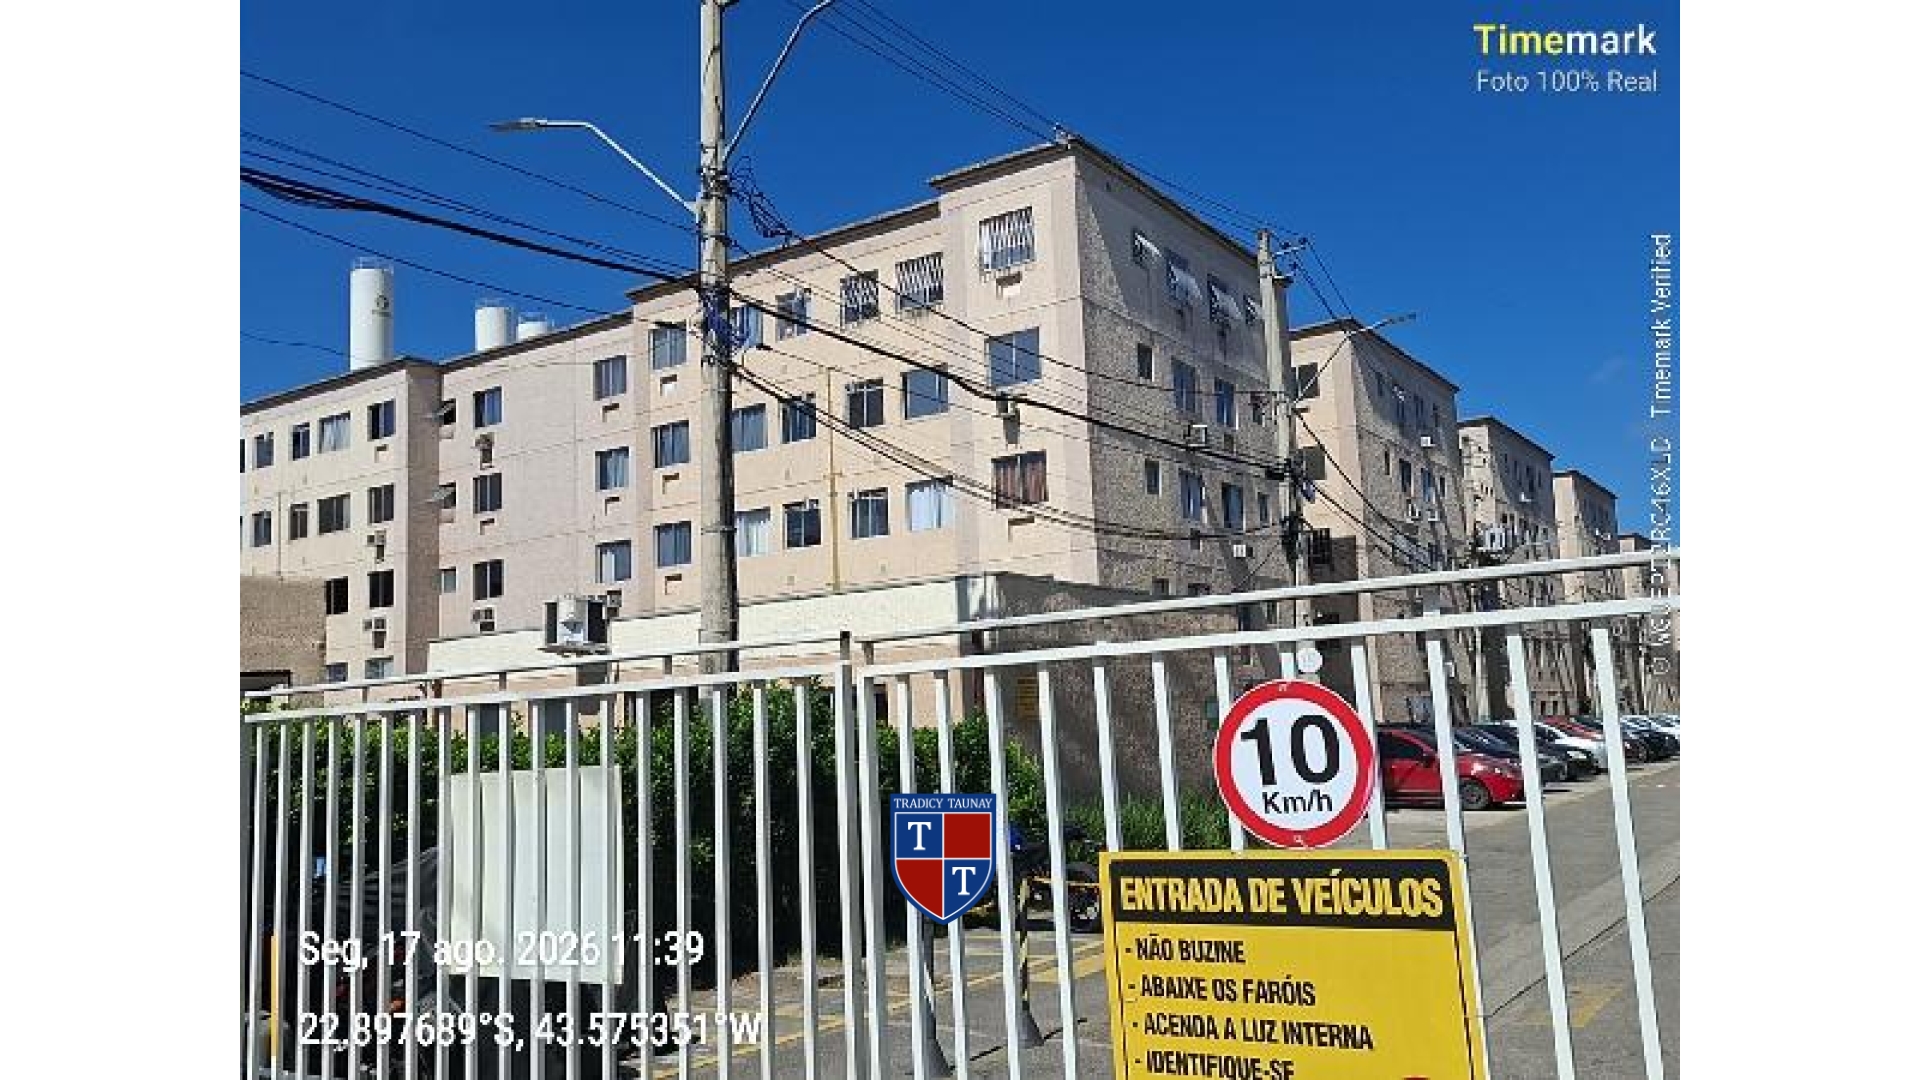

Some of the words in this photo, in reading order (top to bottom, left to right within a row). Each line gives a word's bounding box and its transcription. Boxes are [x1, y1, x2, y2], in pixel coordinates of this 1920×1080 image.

[1241, 715, 1340, 785] 10
[1262, 790, 1333, 814] Km/h
[1120, 876, 1244, 912] ENTRADA
[1248, 878, 1287, 913] DE
[1291, 869, 1443, 917] VEÍCULOS
[1135, 933, 1173, 961] NÃO
[1180, 939, 1247, 963] BUZINE
[1140, 974, 1206, 1001] ABAIXE
[1213, 979, 1237, 1002] OS
[1243, 974, 1316, 1006] FARÓIS
[1144, 1013, 1219, 1040] ACENDA
[1223, 1018, 1237, 1040] A
[1242, 1022, 1279, 1044] LUZ
[1283, 1021, 1375, 1050] INTERNA
